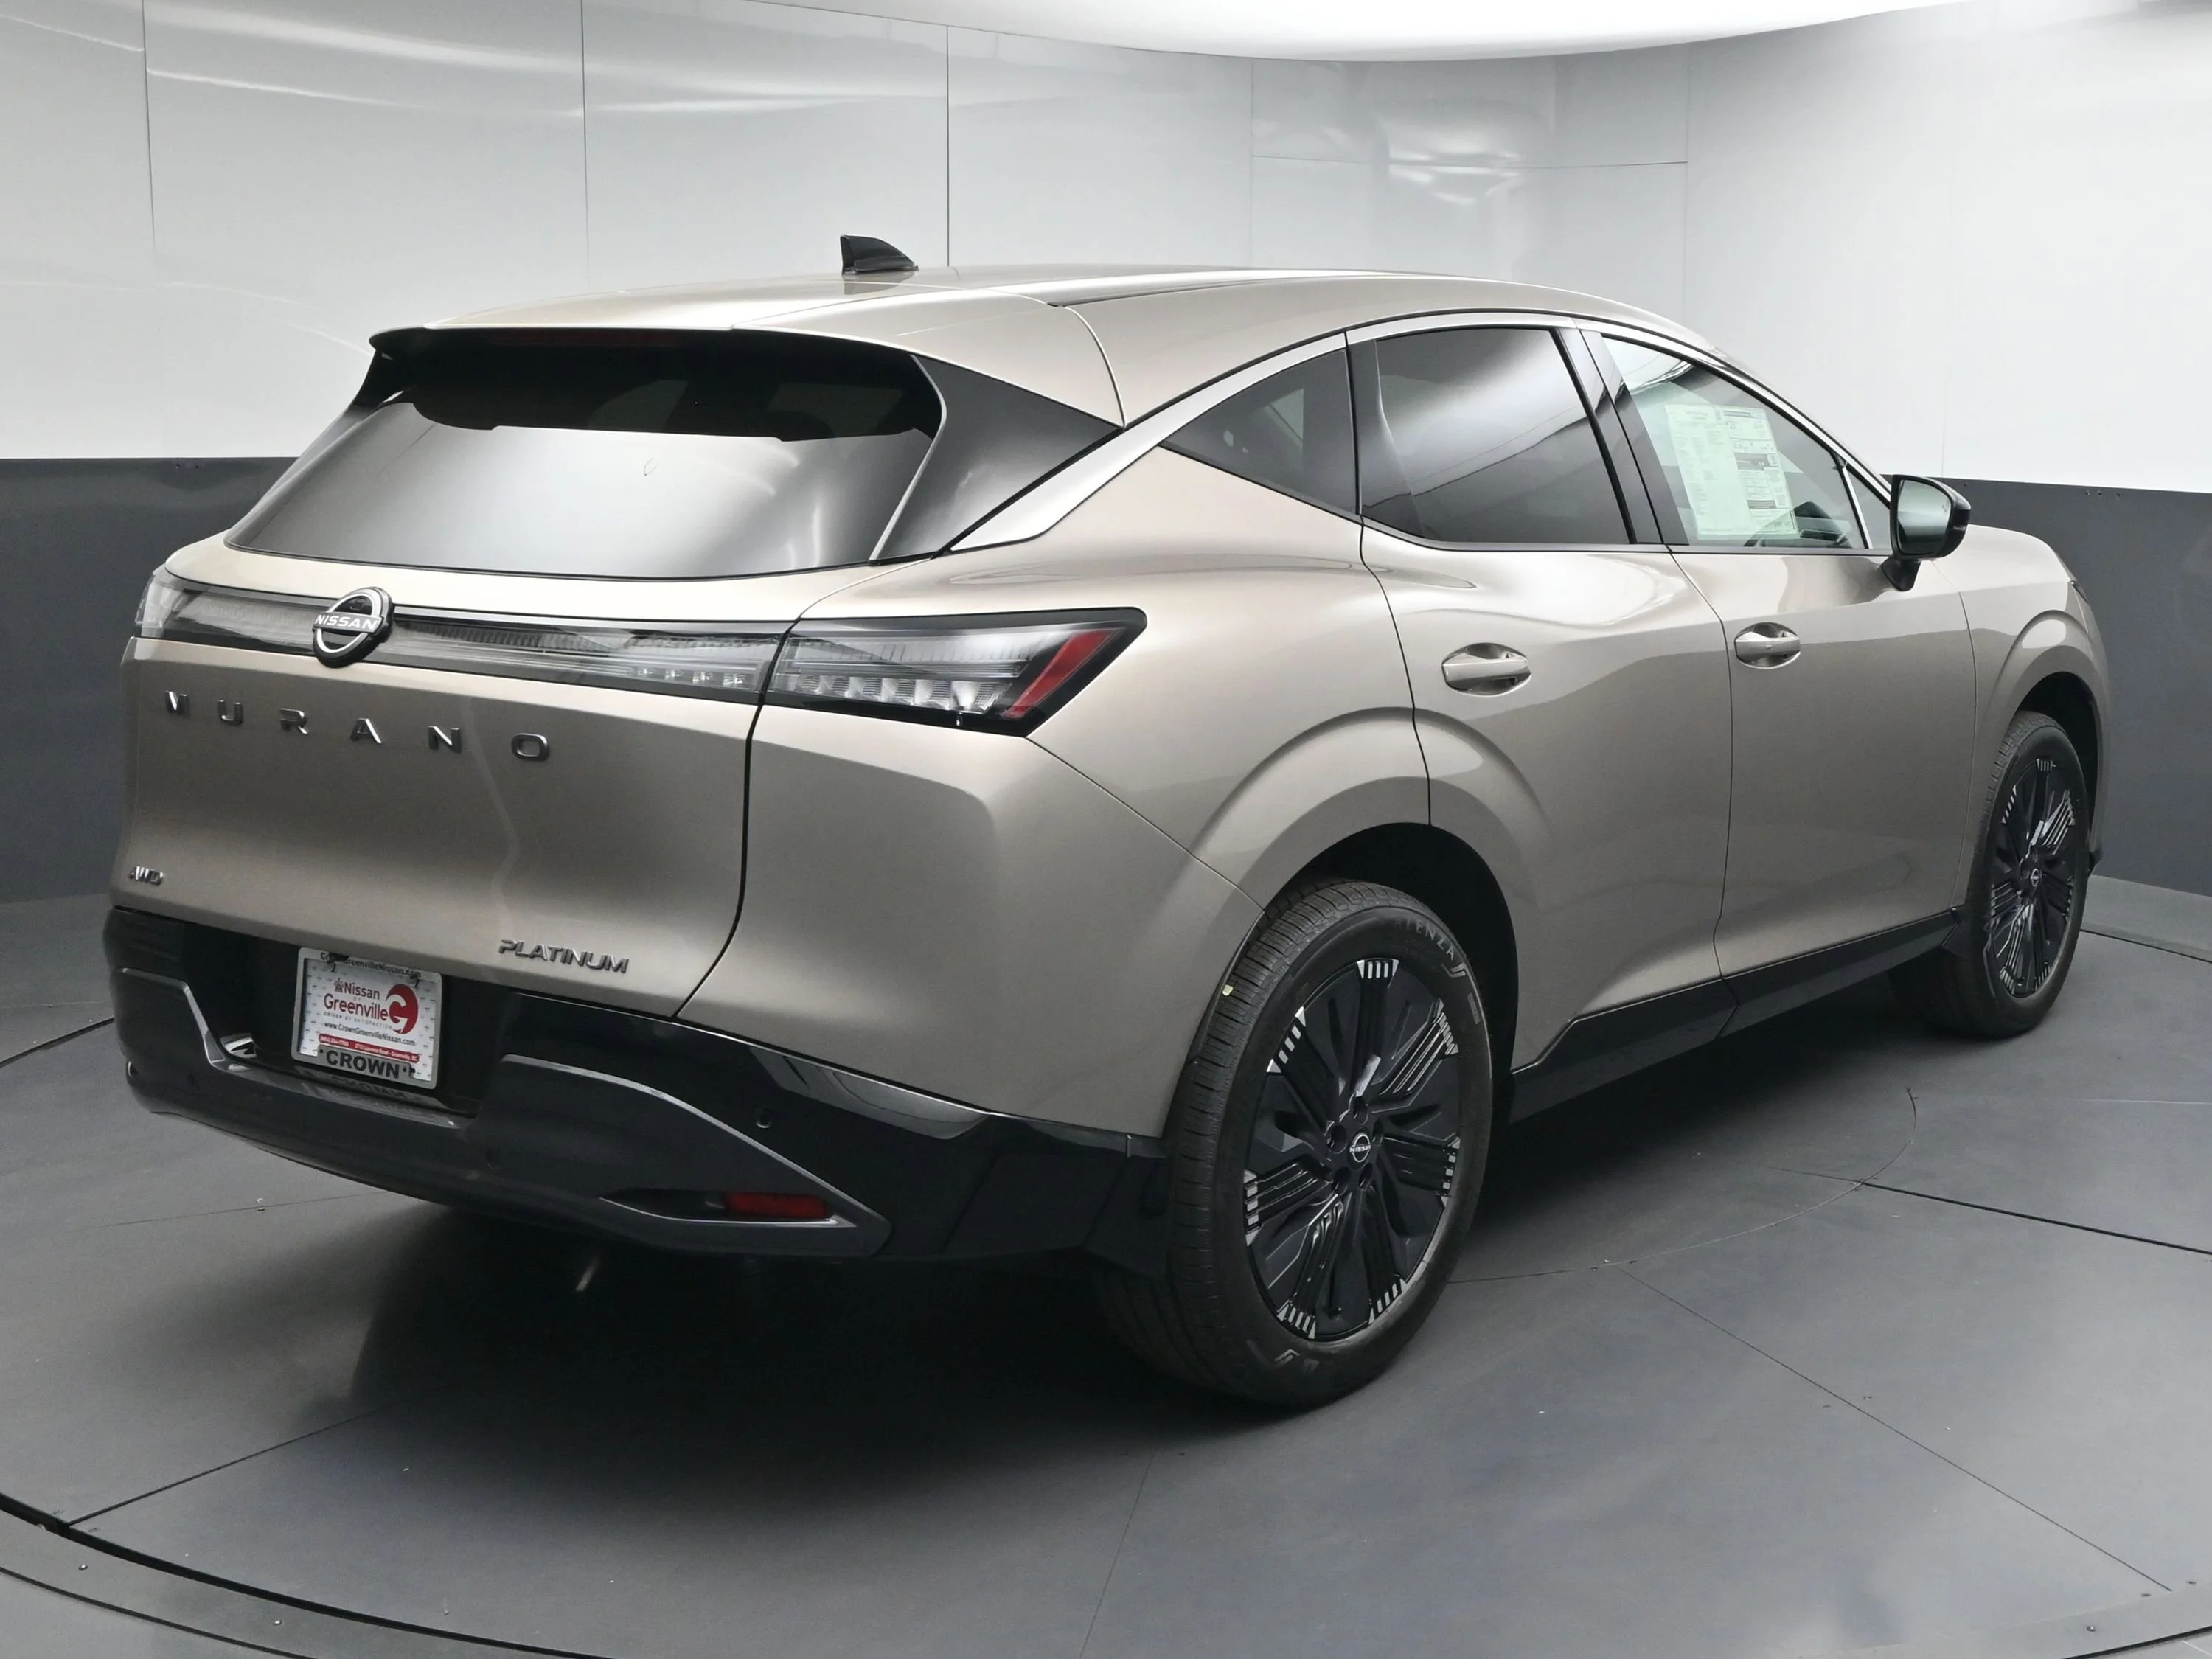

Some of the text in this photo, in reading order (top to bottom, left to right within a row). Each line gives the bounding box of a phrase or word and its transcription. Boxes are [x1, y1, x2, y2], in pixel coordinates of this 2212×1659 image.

[314, 614, 378, 630] NISSAN
[164, 690, 550, 761] MURANO
[129, 866, 164, 886] AWD
[498, 939, 629, 973] PLATINUM
[344, 981, 380, 1001] Nissan
[324, 993, 389, 1021] Greenville
[324, 1022, 416, 1046] www.CrownGreenvilleNissan.com
[326, 1049, 400, 1079] CROWN
[1349, 1144, 1371, 1153] NISSAN
